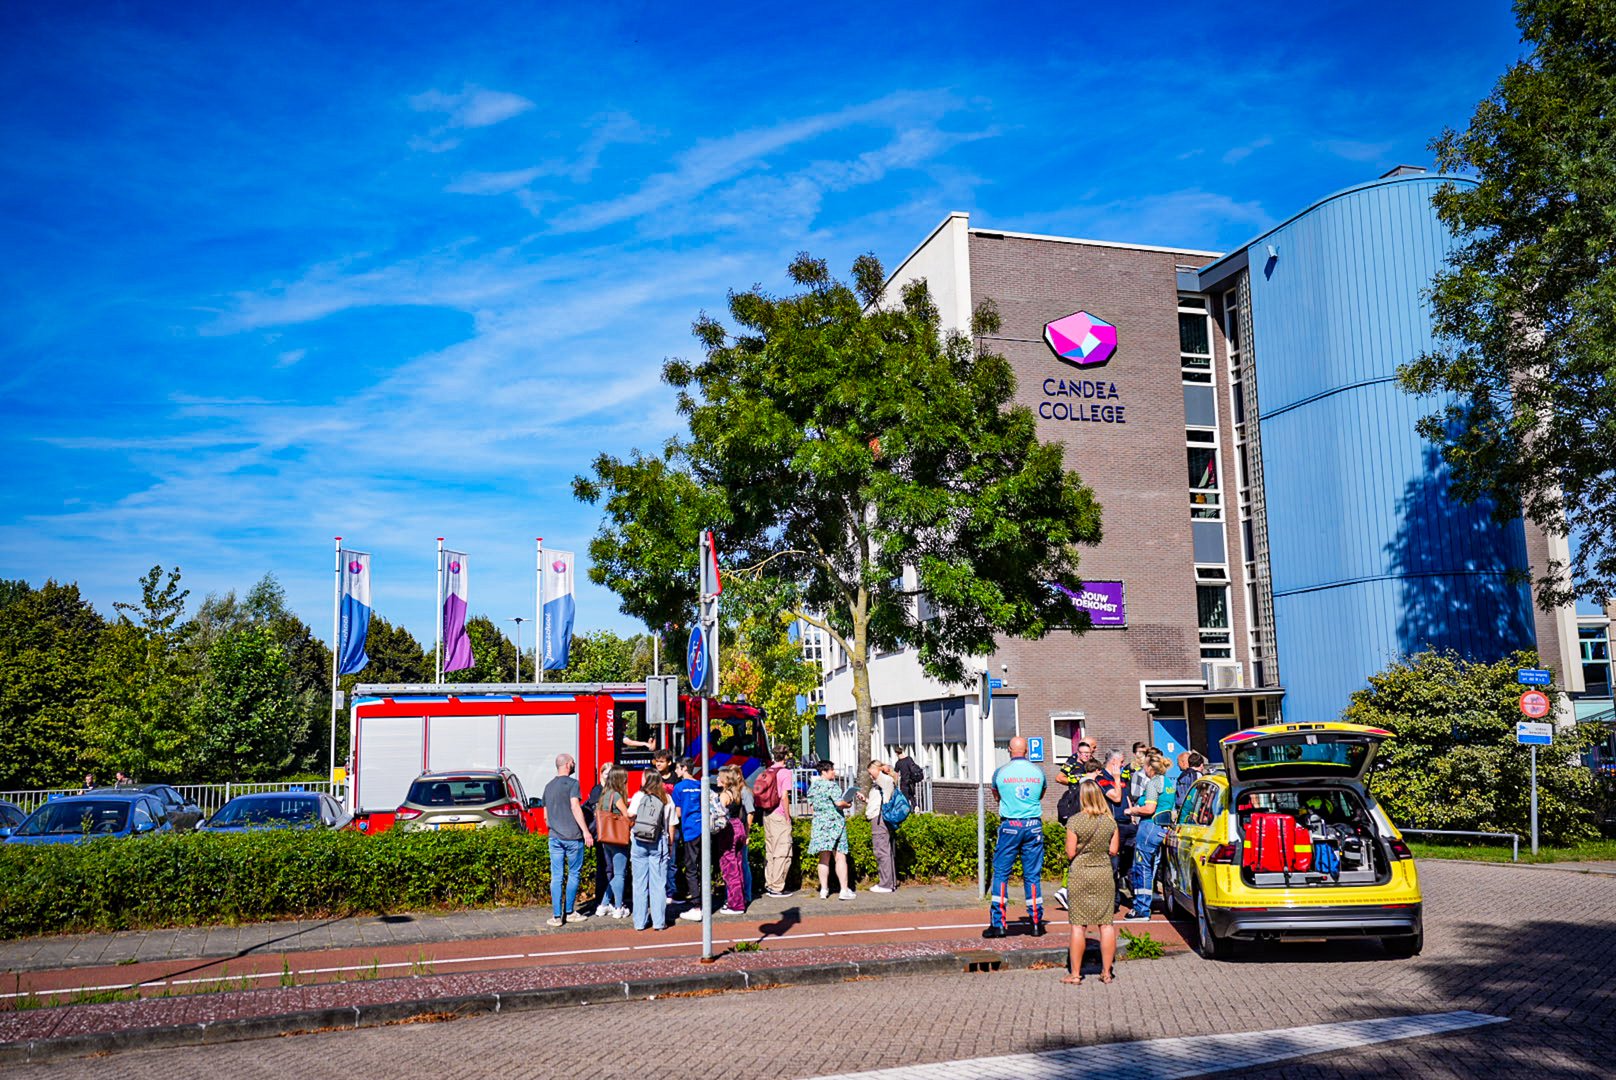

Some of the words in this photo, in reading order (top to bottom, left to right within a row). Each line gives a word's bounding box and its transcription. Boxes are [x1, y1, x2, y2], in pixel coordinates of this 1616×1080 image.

[1043, 378, 1119, 400] CANDEA
[1039, 402, 1126, 423] COLLEGE
[1071, 598, 1118, 613] TOEKOMST
[1081, 591, 1109, 602] JOUW
[606, 709, 614, 741] 07-5631
[1031, 739, 1040, 752] P
